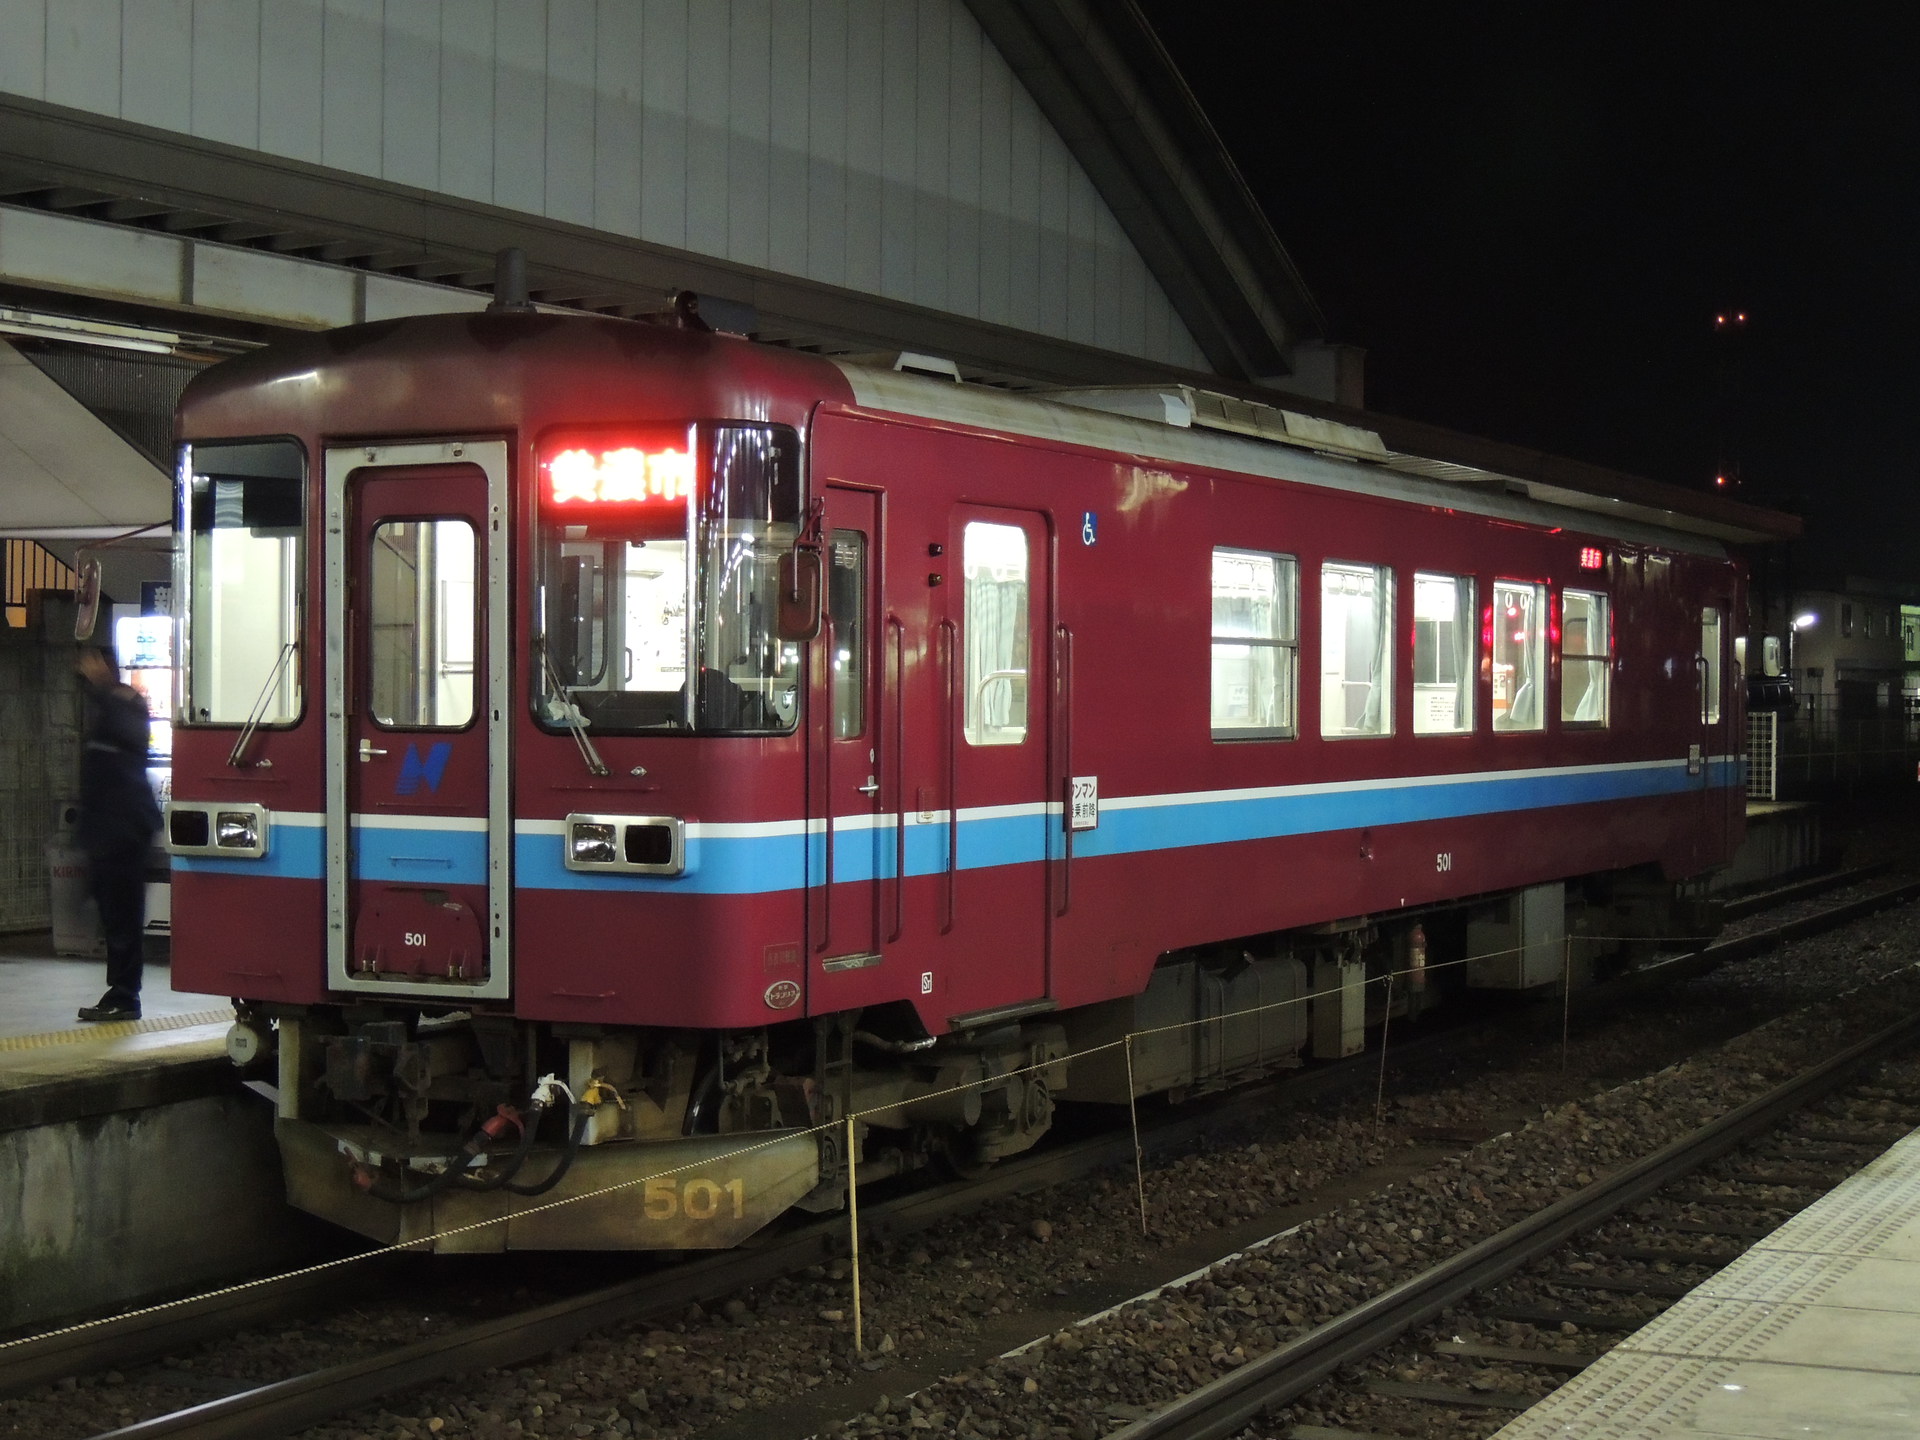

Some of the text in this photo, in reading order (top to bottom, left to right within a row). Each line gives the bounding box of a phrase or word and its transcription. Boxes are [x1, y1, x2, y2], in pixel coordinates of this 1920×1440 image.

[1072, 783, 1096, 799] ンマン
[1436, 852, 1451, 872] 501
[404, 932, 427, 946] 501
[643, 1178, 743, 1219] 501
